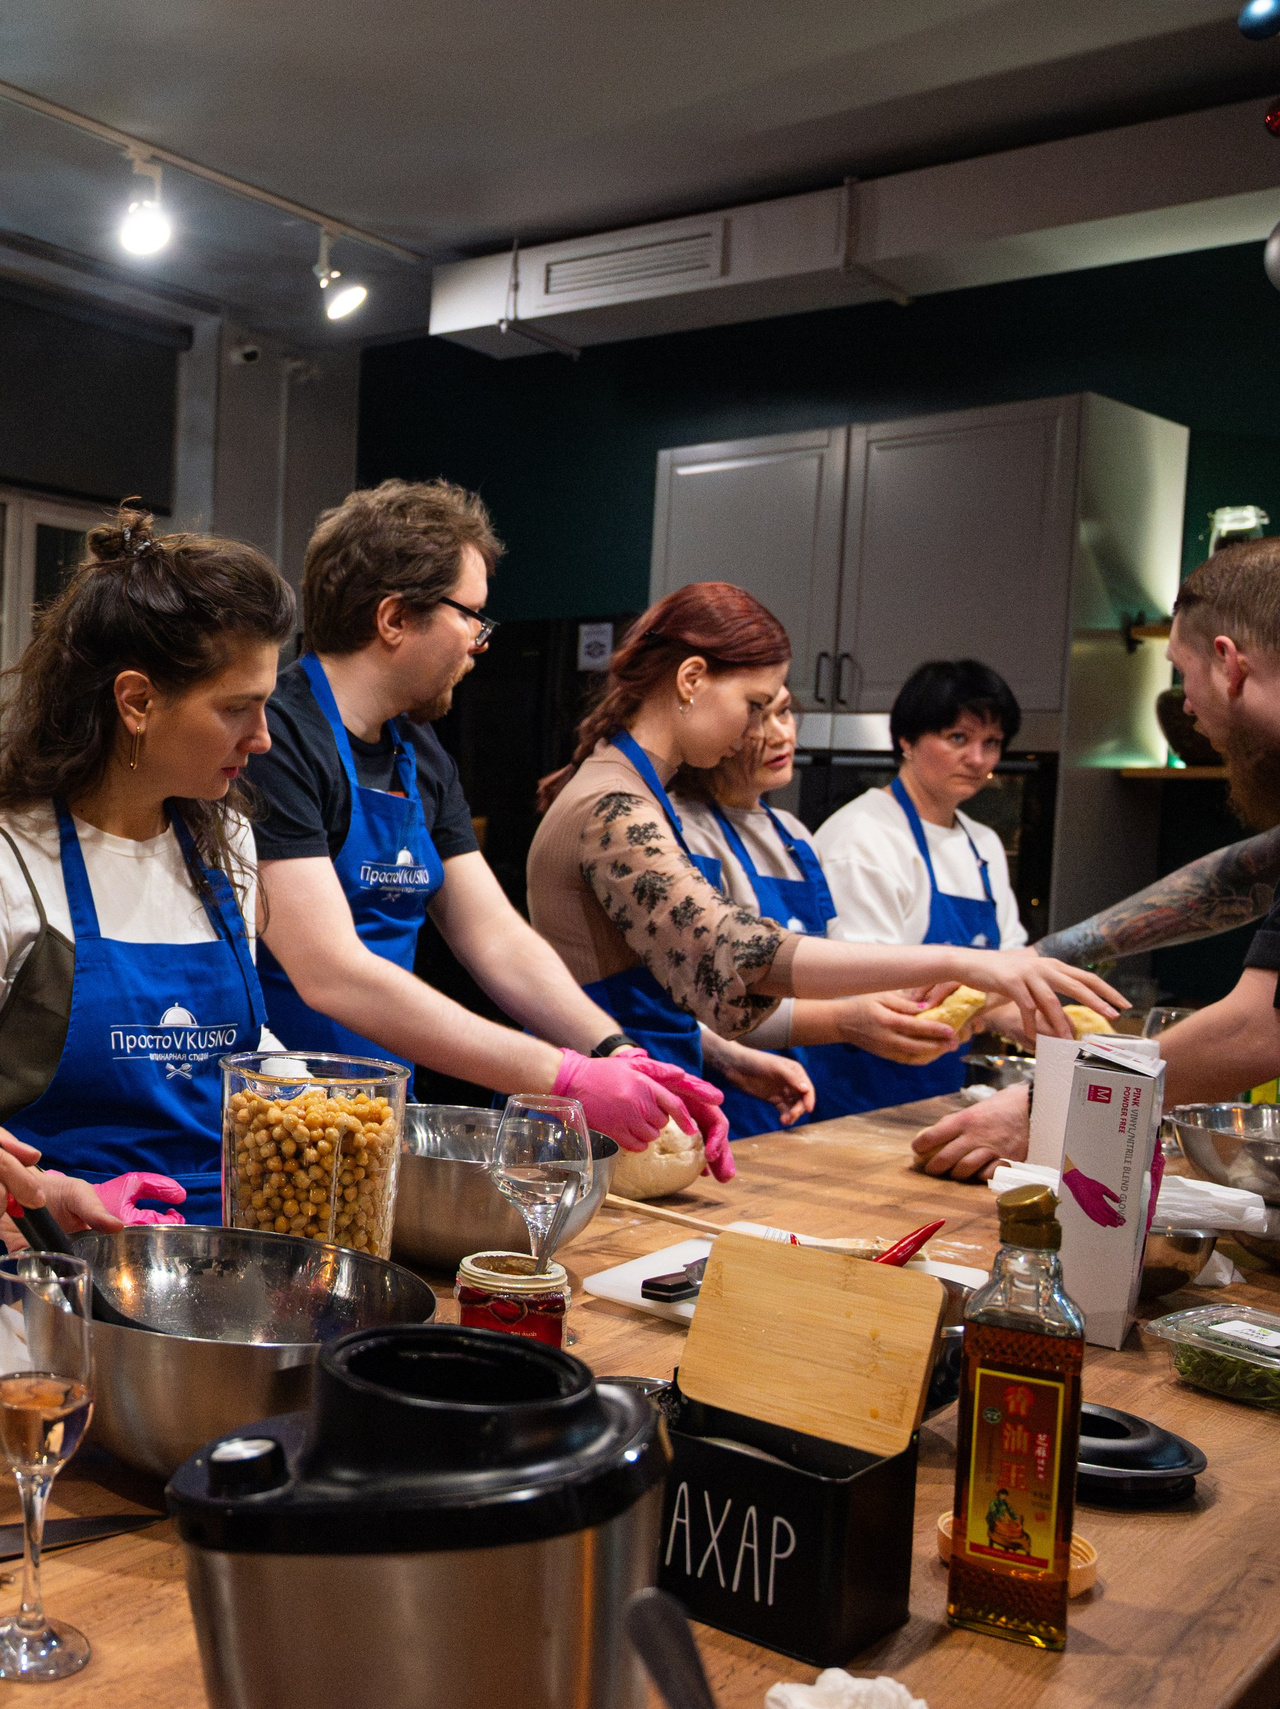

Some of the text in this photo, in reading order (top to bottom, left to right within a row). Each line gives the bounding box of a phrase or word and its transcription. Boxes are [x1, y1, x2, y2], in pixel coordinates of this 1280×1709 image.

[111, 1029, 237, 1054] ПростоVKUSNO
[1096, 1088, 1110, 1101] M
[1131, 1087, 1142, 1107] PINK
[1118, 1086, 1131, 1134] POWDER FREE
[1124, 1108, 1139, 1165] VINYL/NITRILE
[1120, 1166, 1132, 1192] BLEND
[663, 1481, 797, 1606] АХАР
